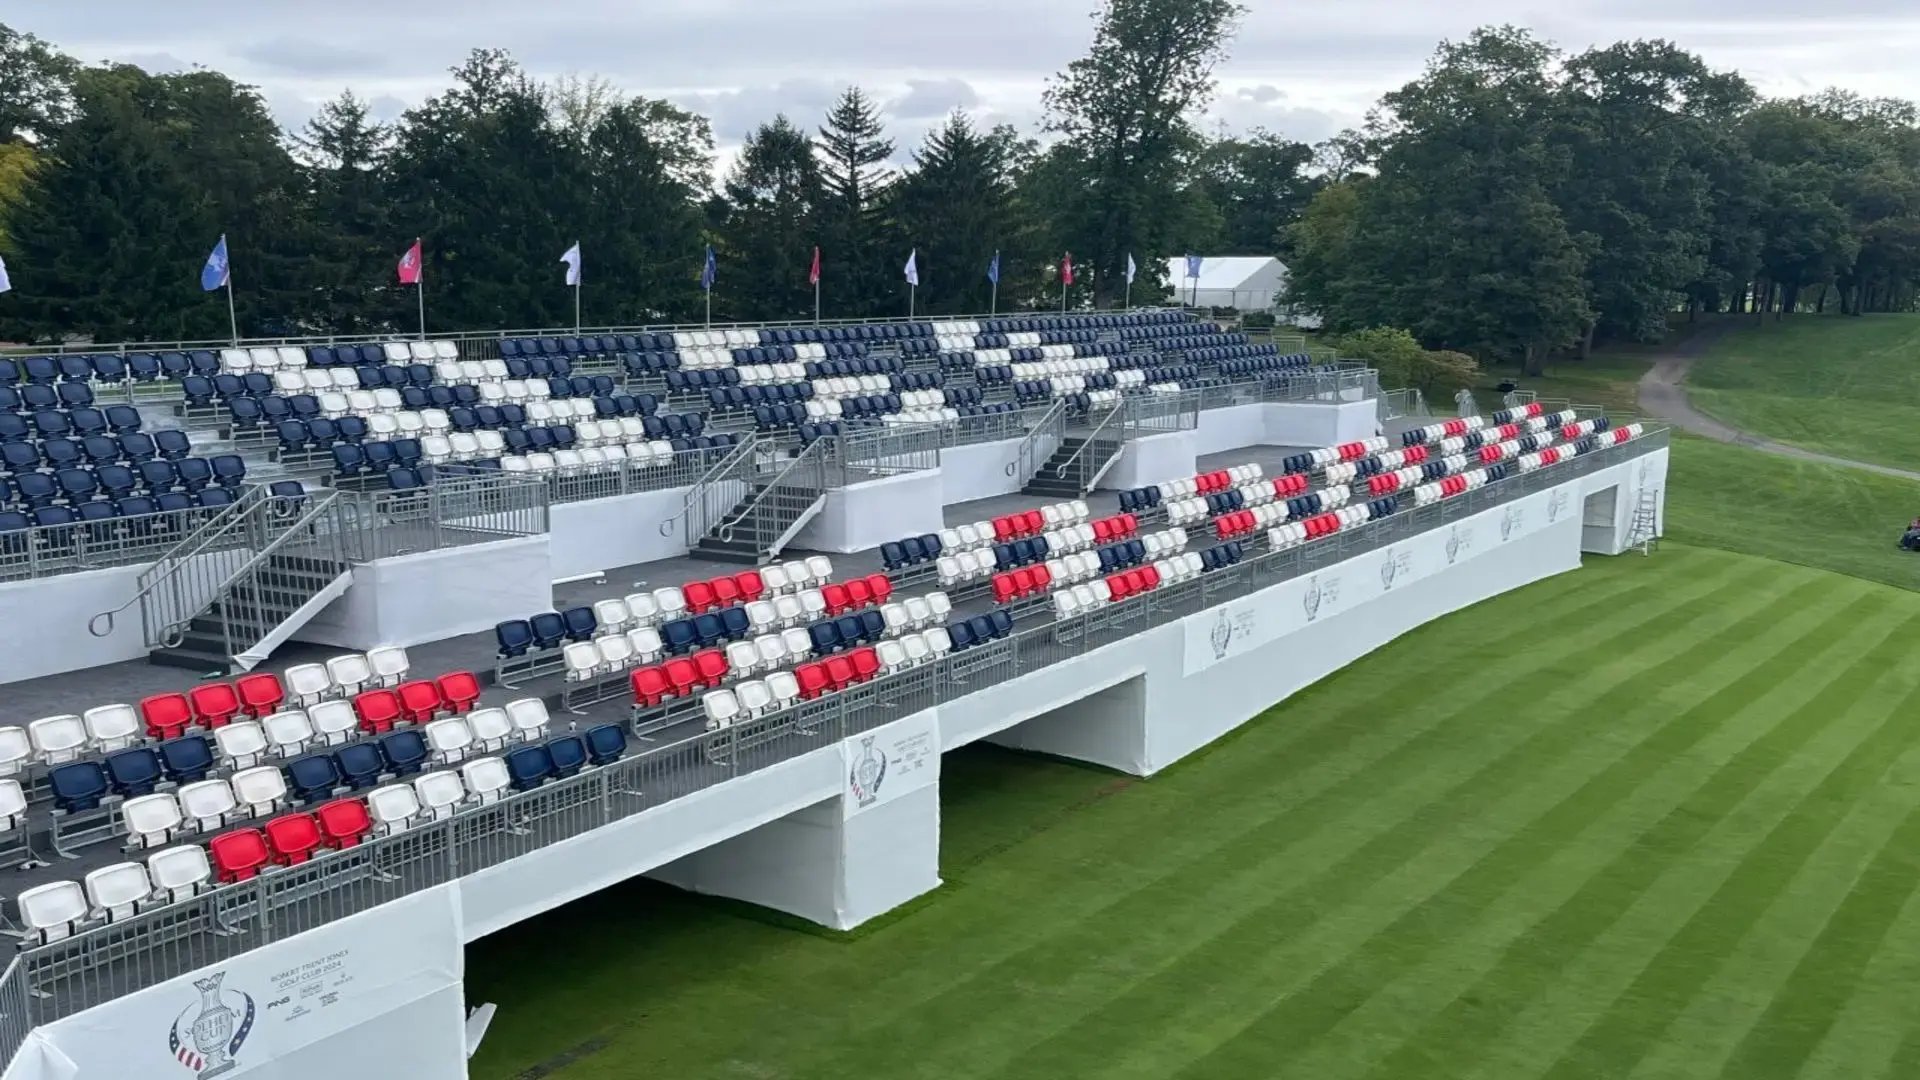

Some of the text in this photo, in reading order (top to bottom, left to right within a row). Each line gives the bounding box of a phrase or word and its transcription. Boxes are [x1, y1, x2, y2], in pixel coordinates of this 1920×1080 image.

[270, 967, 299, 982] ROBERT
[302, 958, 326, 971] TRENT
[280, 960, 342, 988] GOLF CLUB 2024
[199, 1023, 226, 1042] CUP
